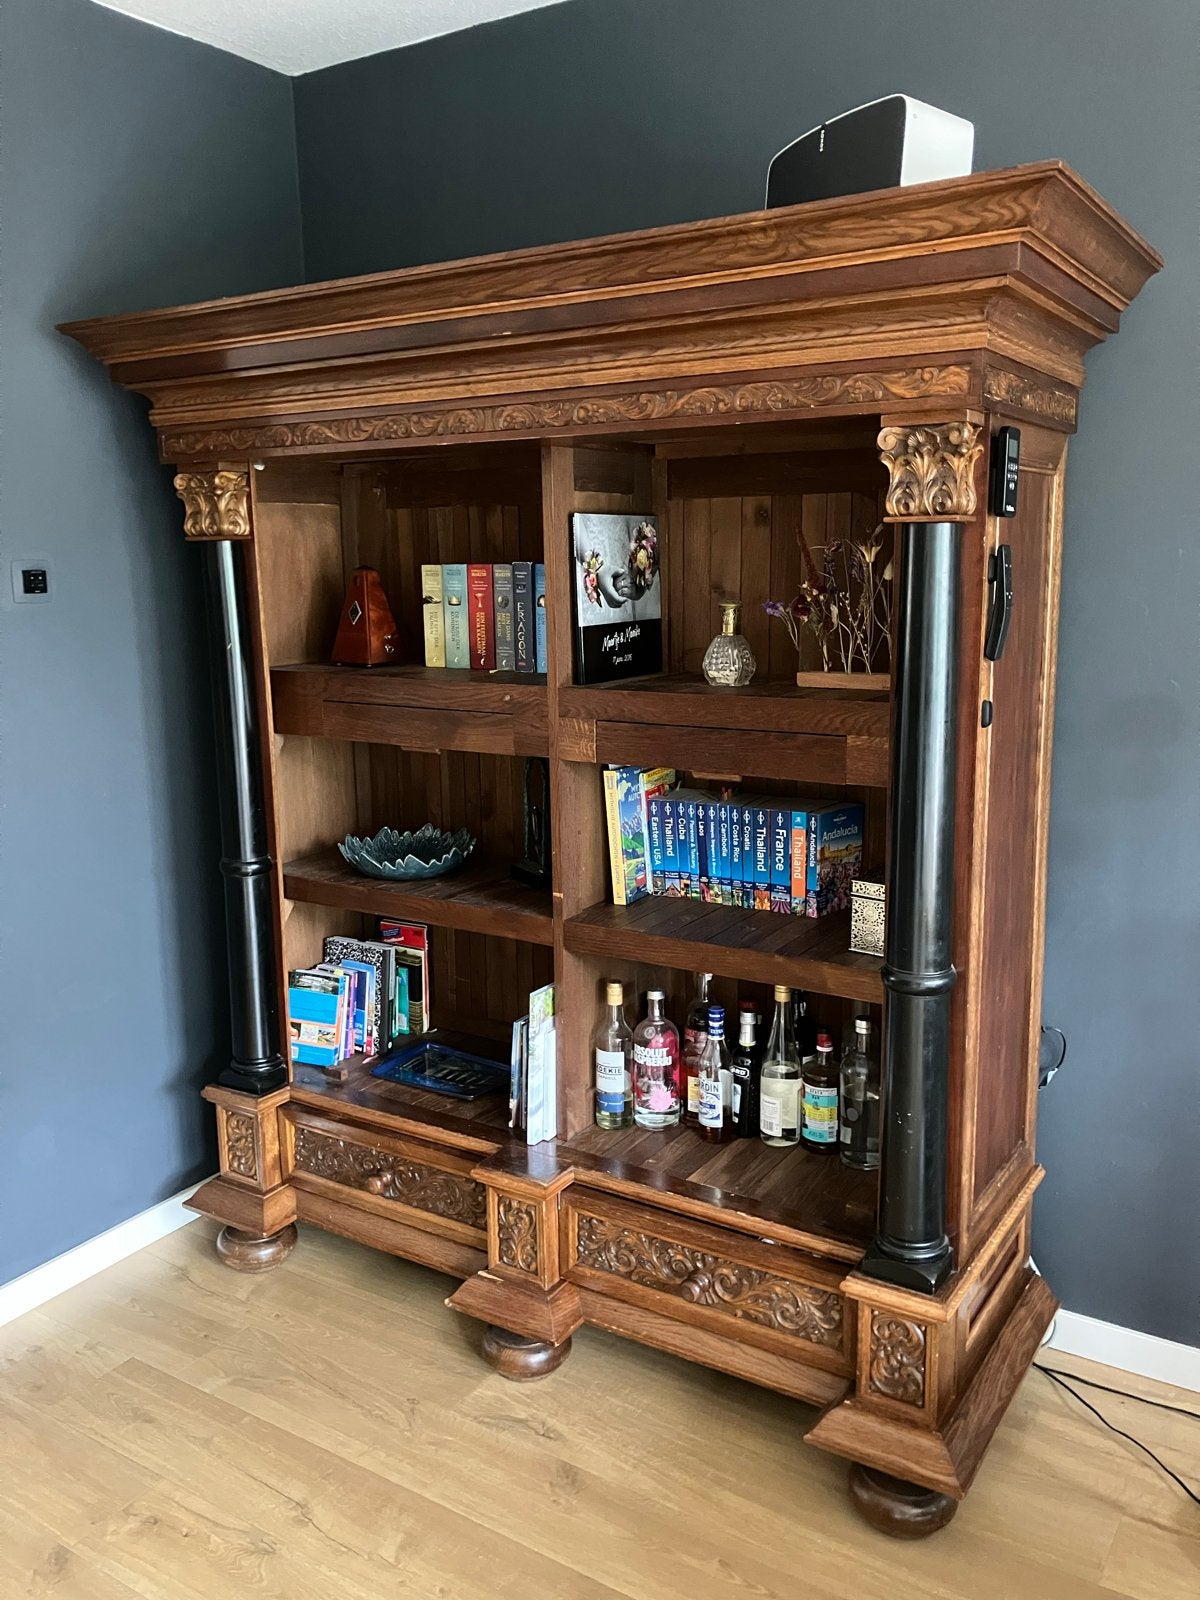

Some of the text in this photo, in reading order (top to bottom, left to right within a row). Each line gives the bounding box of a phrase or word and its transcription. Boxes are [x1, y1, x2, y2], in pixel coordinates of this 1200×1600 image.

[517, 601, 526, 660] ERAGON
[651, 817, 660, 847] Eastern
[664, 817, 675, 857] Thailand
[678, 818, 686, 840] Cuba
[756, 827, 767, 872] Thailand
[775, 828, 786, 871] France
[653, 848, 661, 865] USA
[793, 835, 803, 879] Thailand
